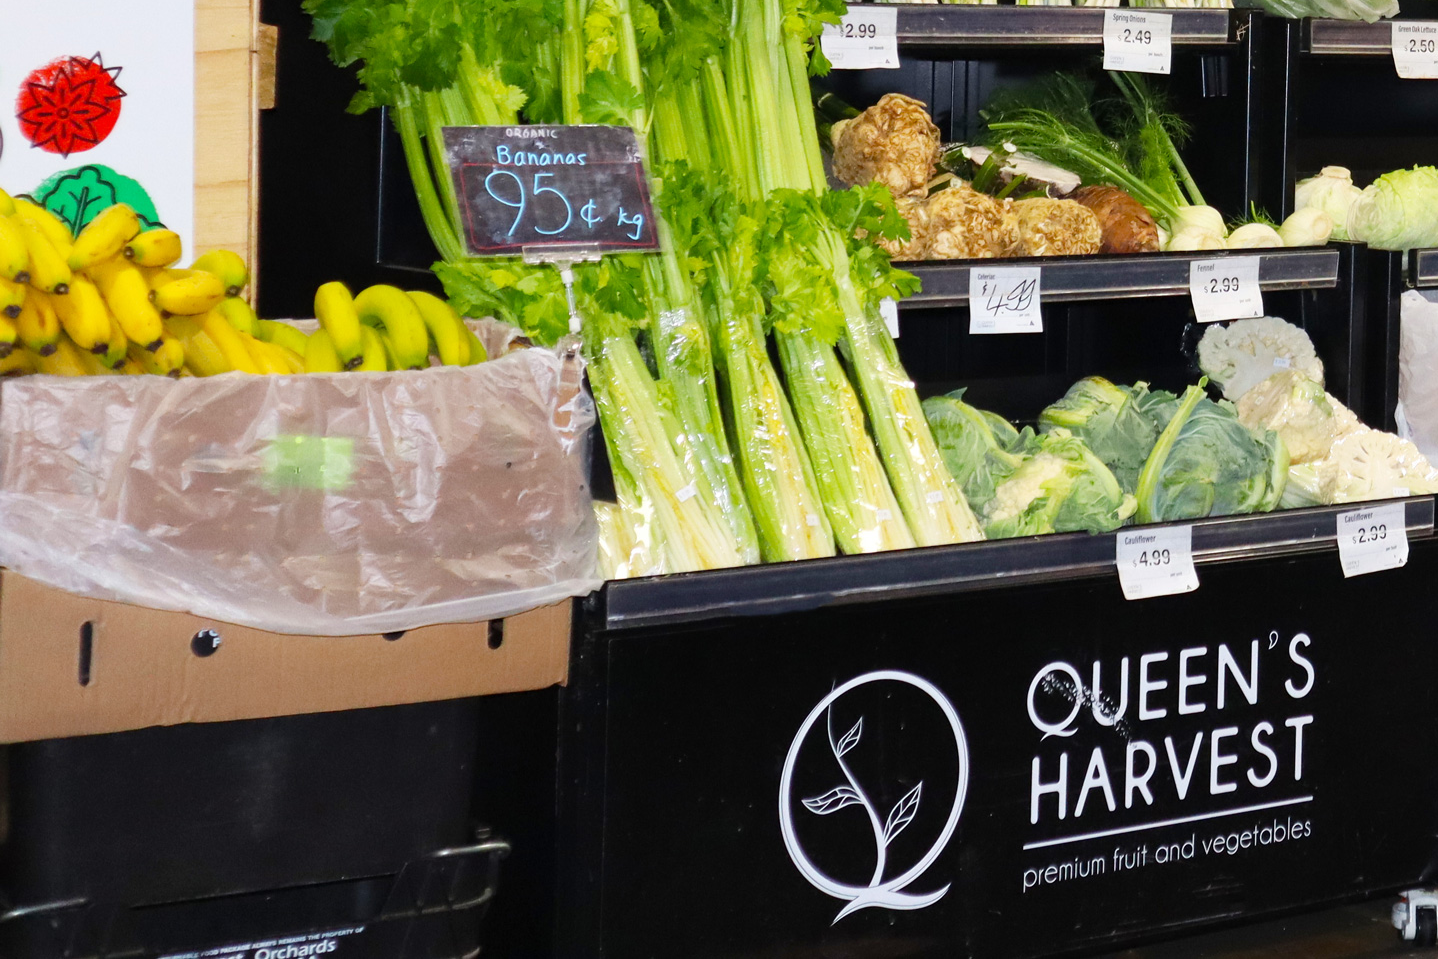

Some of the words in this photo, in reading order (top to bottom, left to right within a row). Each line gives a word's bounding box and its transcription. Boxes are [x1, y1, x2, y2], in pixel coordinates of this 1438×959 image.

[1113, 13, 1129, 24] Spring
[1129, 14, 1147, 24] Onions
[845, 23, 876, 39] 2.99
[1398, 25, 1412, 33] Green
[1411, 25, 1420, 33] Oak
[1420, 26, 1437, 34] Lettuce
[505, 128, 559, 139] ORGANIC
[496, 144, 587, 167] Bananas
[617, 207, 645, 241] kg
[1197, 263, 1215, 273] Fennel
[1210, 277, 1240, 294] 2.99
[1344, 512, 1374, 523] Cauliflower
[1124, 534, 1156, 546] Cauliflower
[1358, 524, 1387, 543] 2.99
[1139, 549, 1171, 567] 4.99
[1027, 630, 1315, 742] QUEEN'S
[1030, 715, 1314, 825] HARVEST
[1022, 855, 1106, 893] premium
[1113, 844, 1148, 871] fruit
[1155, 834, 1195, 864] and
[1202, 816, 1312, 856] vegetables
[308, 933, 321, 941] THE
[321, 929, 354, 939] PROPERTY
[355, 926, 365, 934] OF
[254, 939, 336, 959] Orchards
